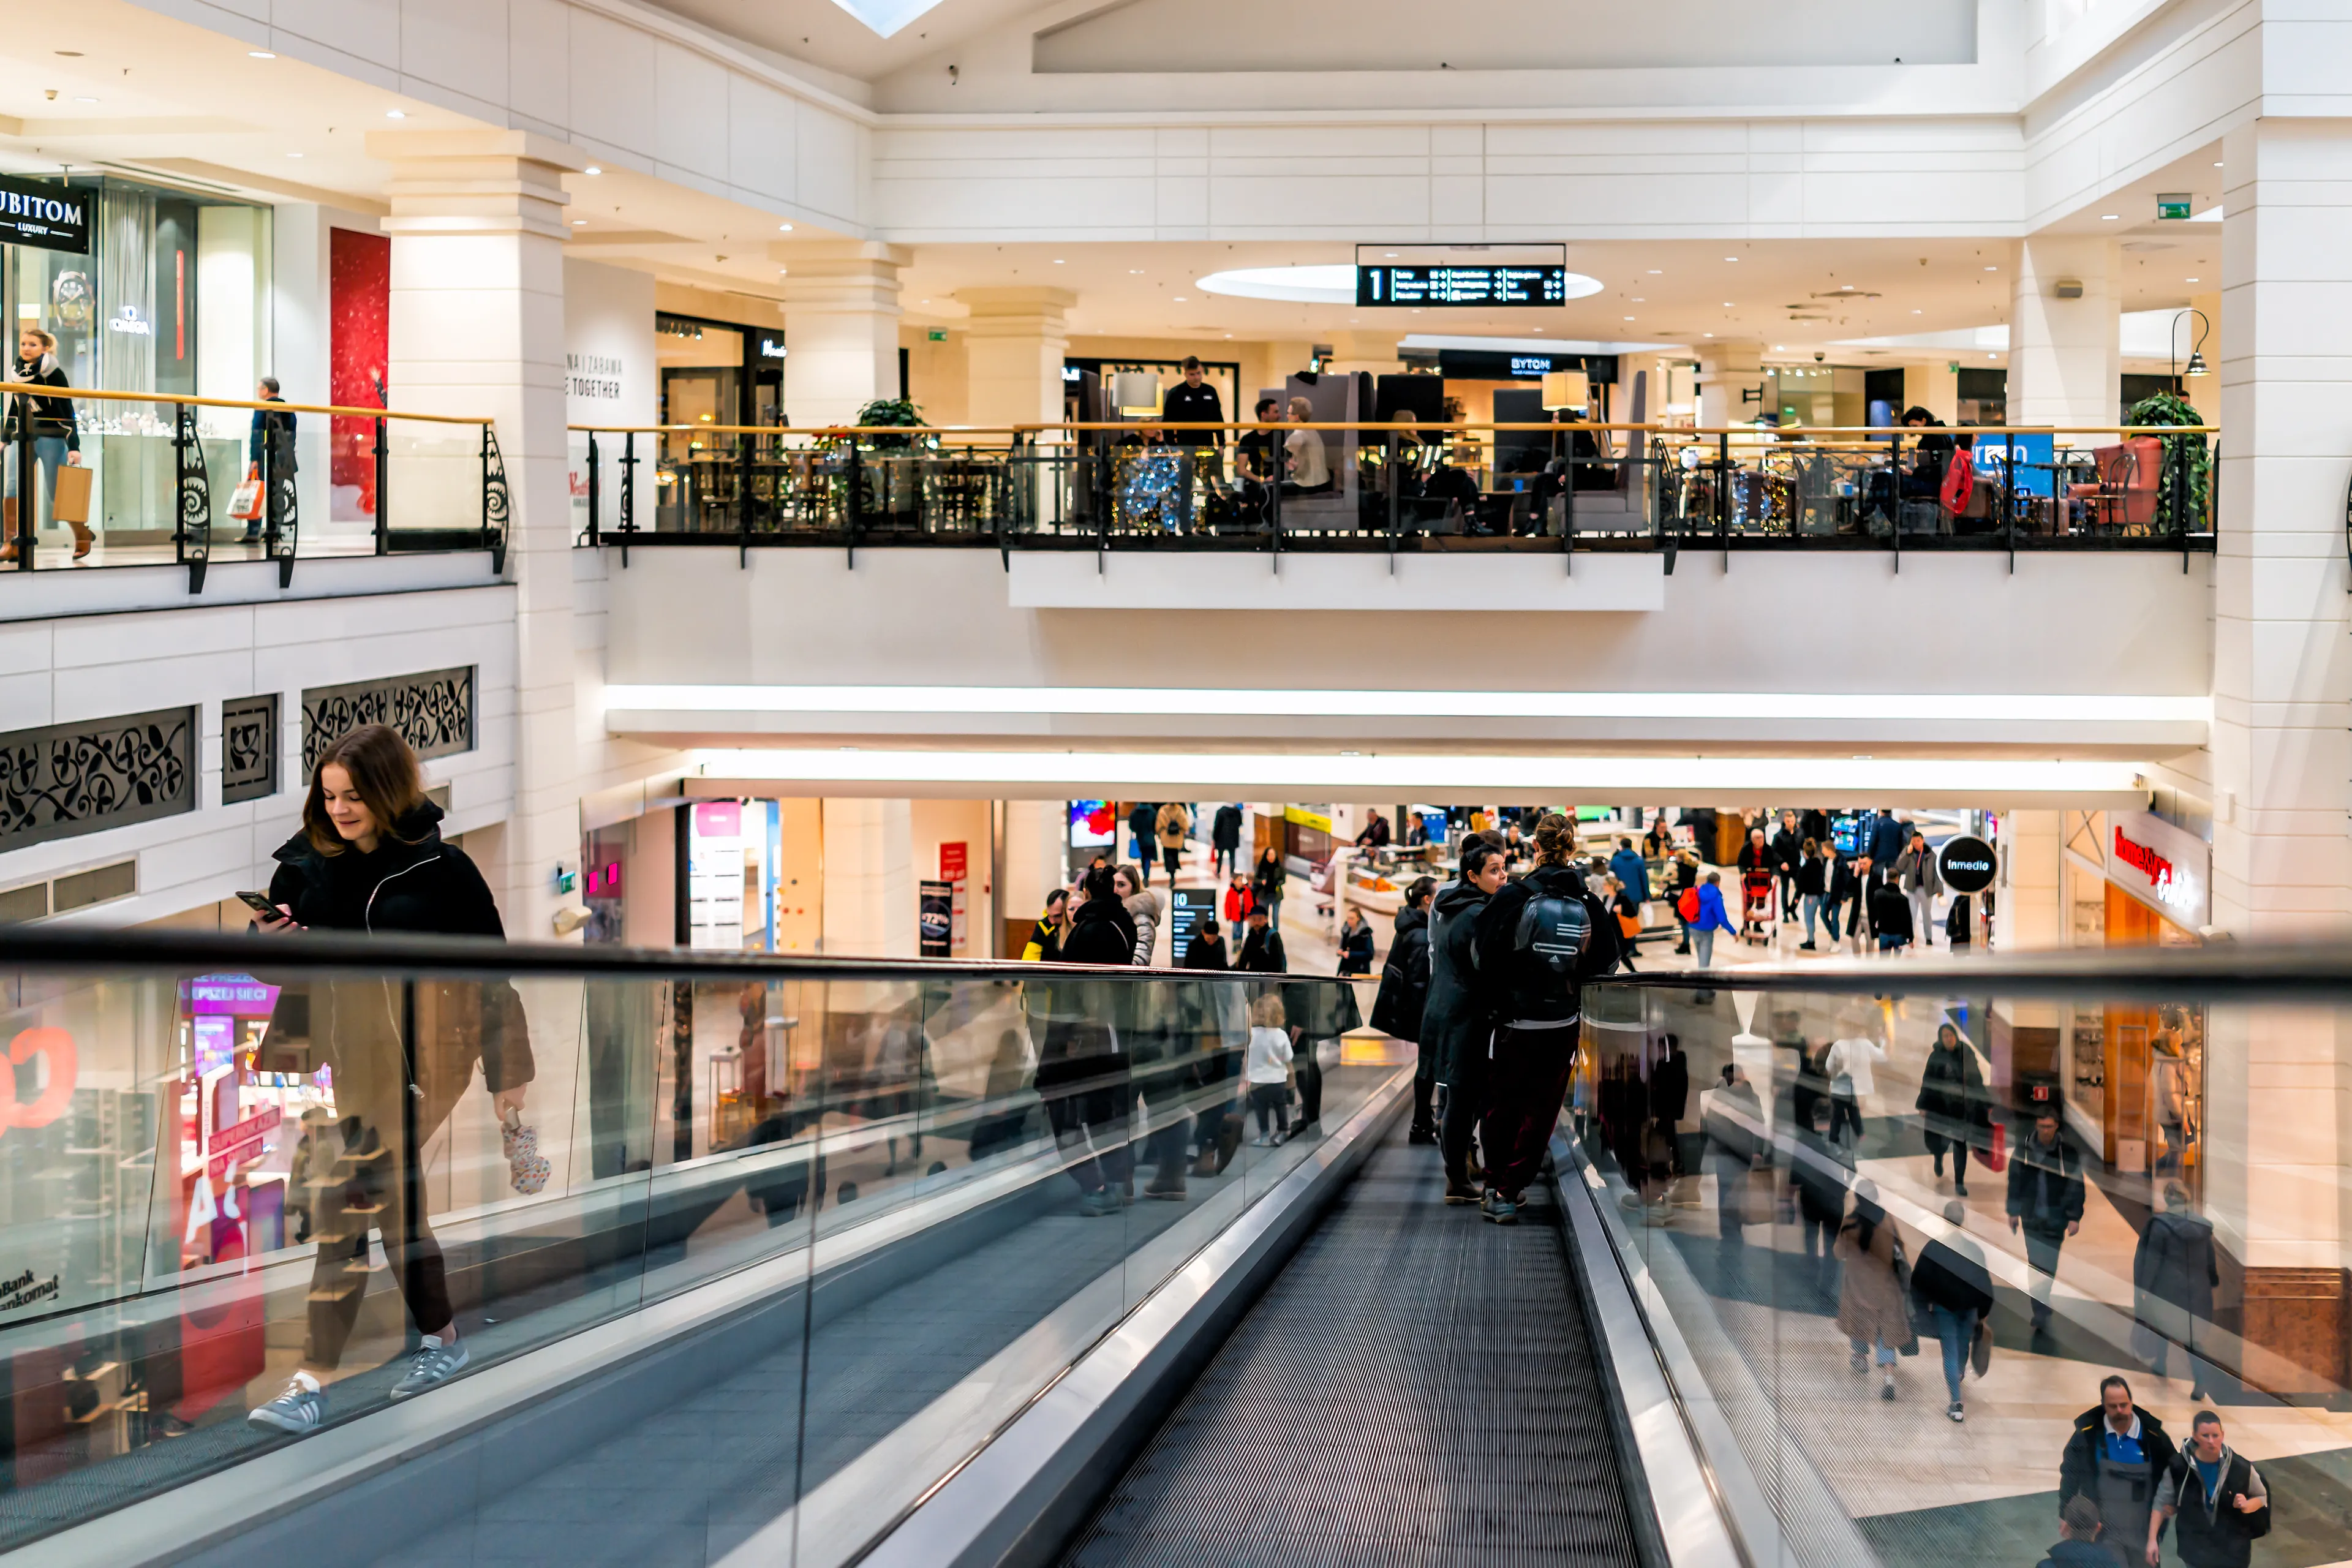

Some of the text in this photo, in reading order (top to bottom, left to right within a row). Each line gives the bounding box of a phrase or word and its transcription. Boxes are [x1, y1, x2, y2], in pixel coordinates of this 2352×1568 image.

[18, 222, 48, 235] LUXURY
[1370, 271, 1381, 300] 1
[1511, 358, 1550, 369] BYTOM
[573, 377, 619, 399] TOGETHER
